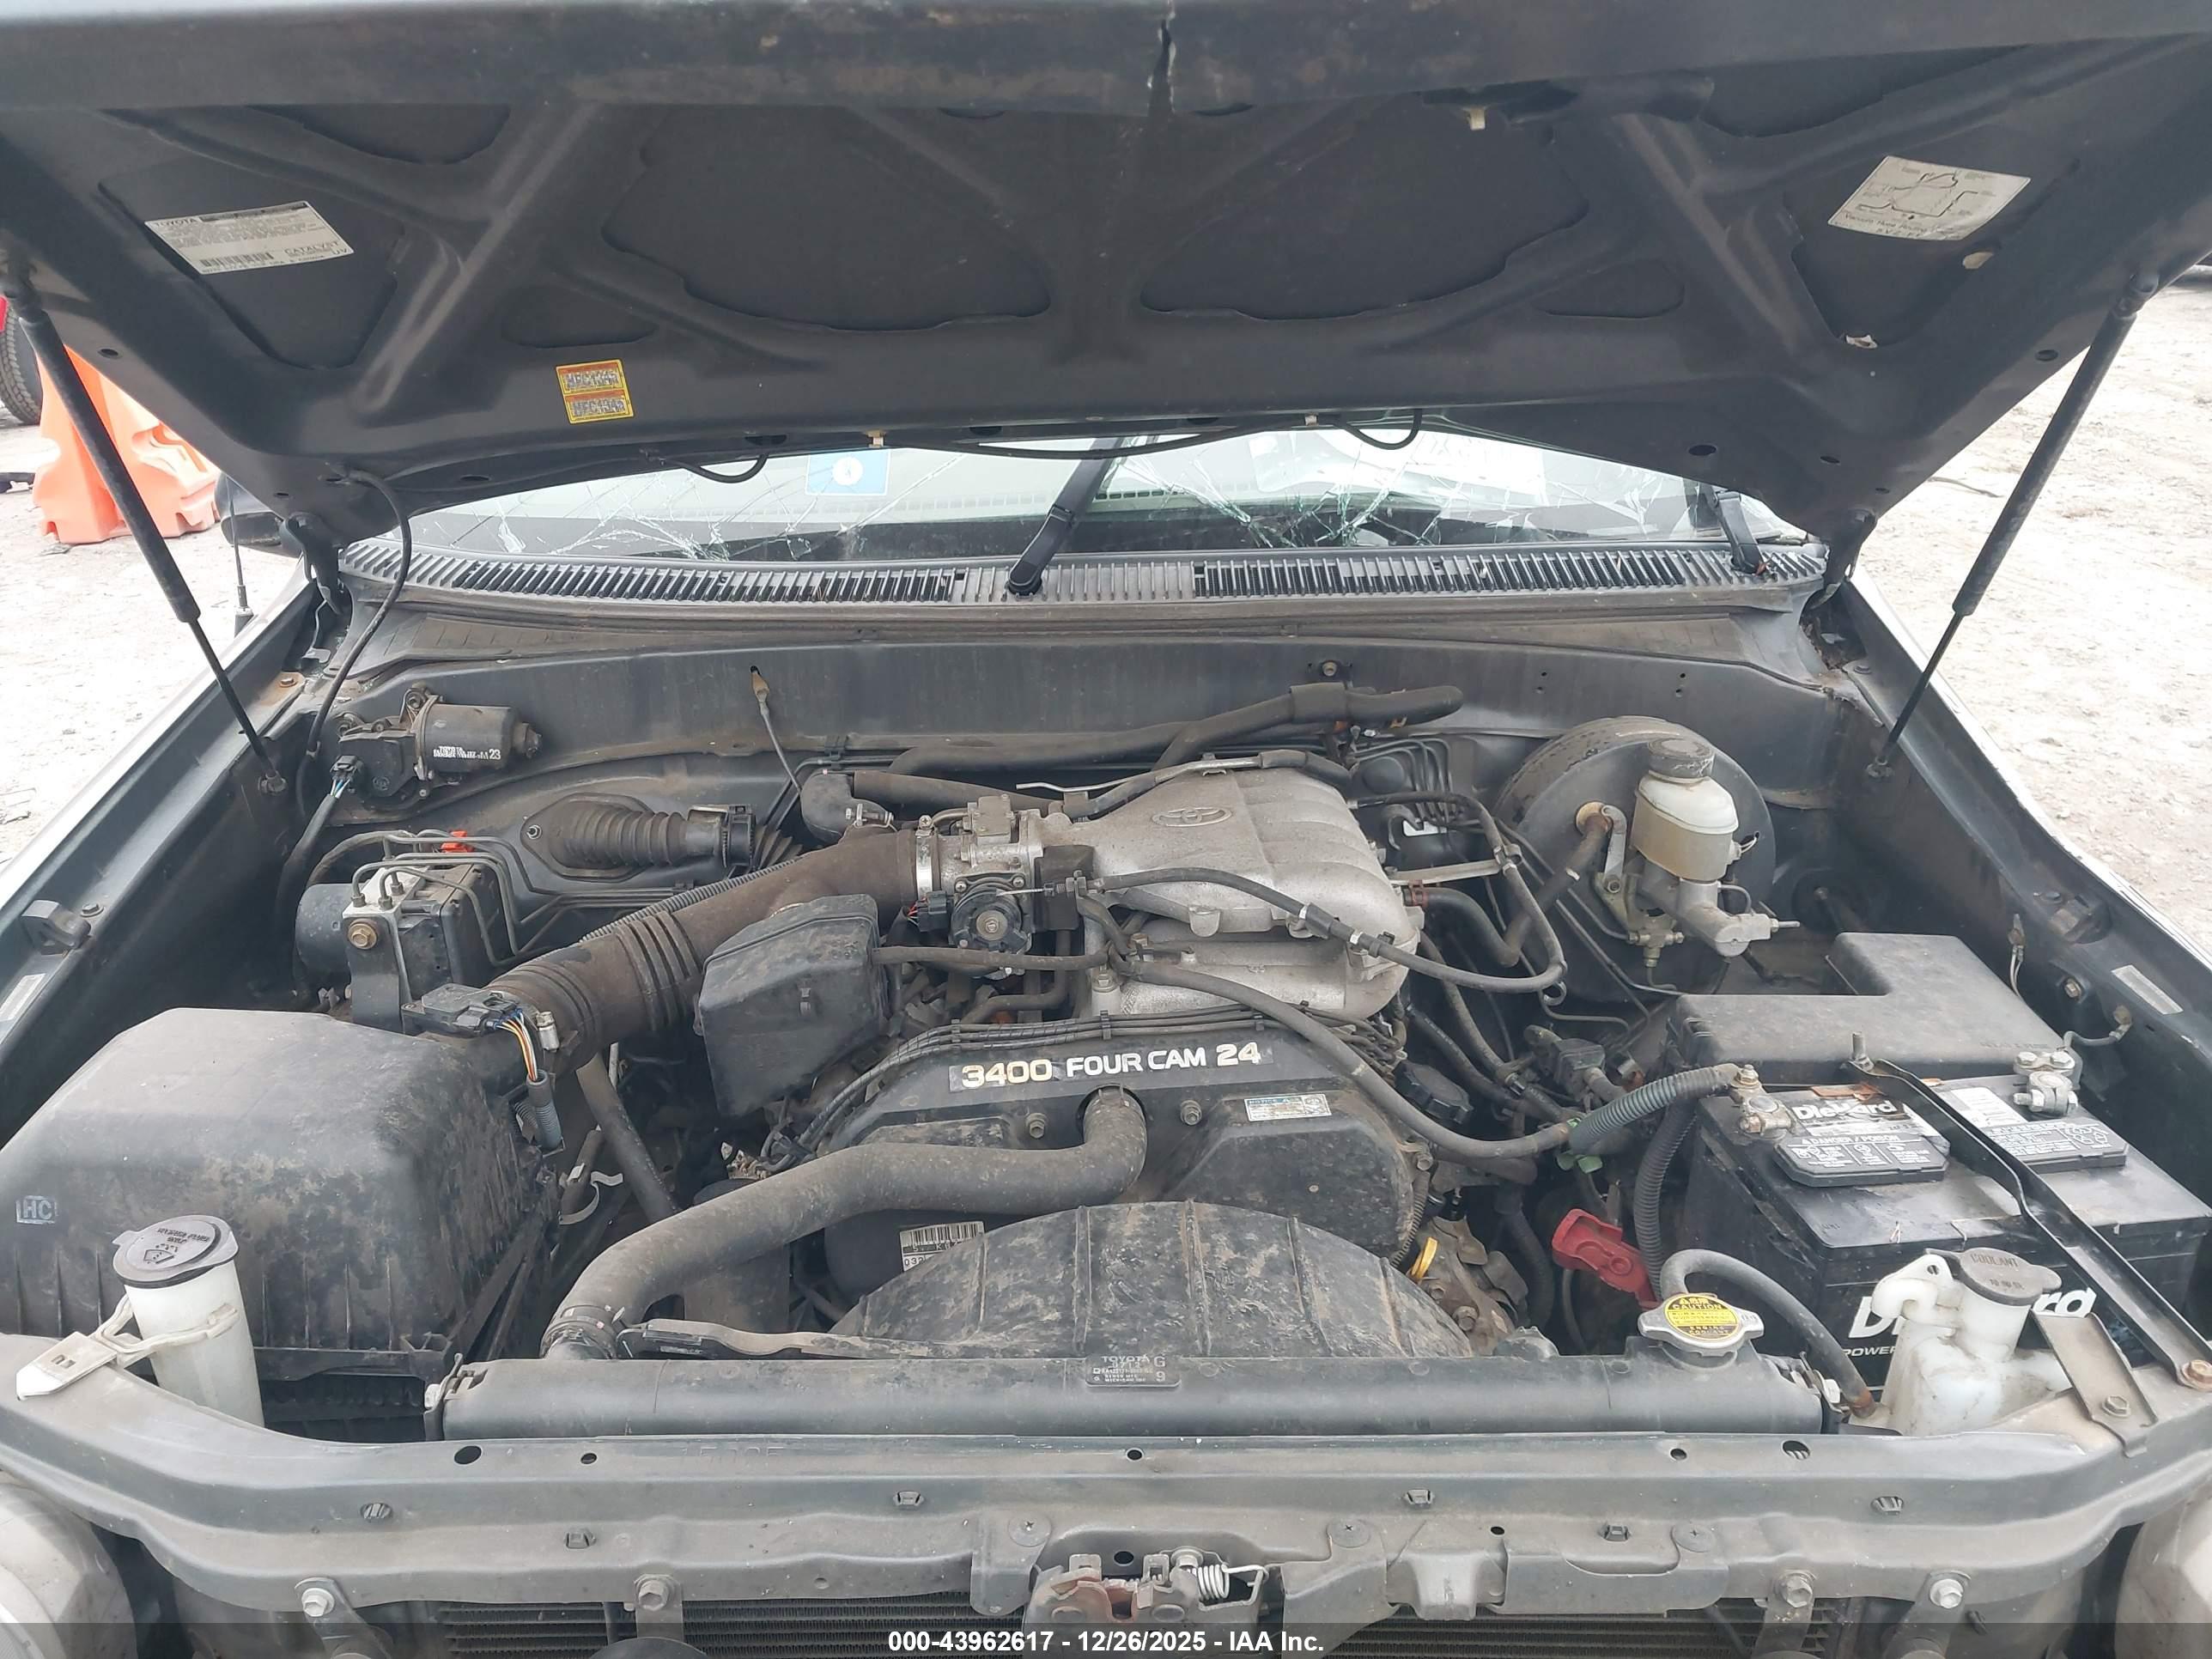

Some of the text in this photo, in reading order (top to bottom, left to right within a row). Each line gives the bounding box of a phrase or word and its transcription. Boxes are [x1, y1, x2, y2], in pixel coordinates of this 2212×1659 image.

[489, 748, 501, 760] 23
[961, 1042, 1261, 1089] 3400 FOUR CAM 24
[1970, 1253, 2019, 1268] COOLANT
[1101, 1354, 1150, 1363] TOYOTA
[1153, 1356, 1166, 1367] G
[1156, 1370, 1166, 1382] 9
